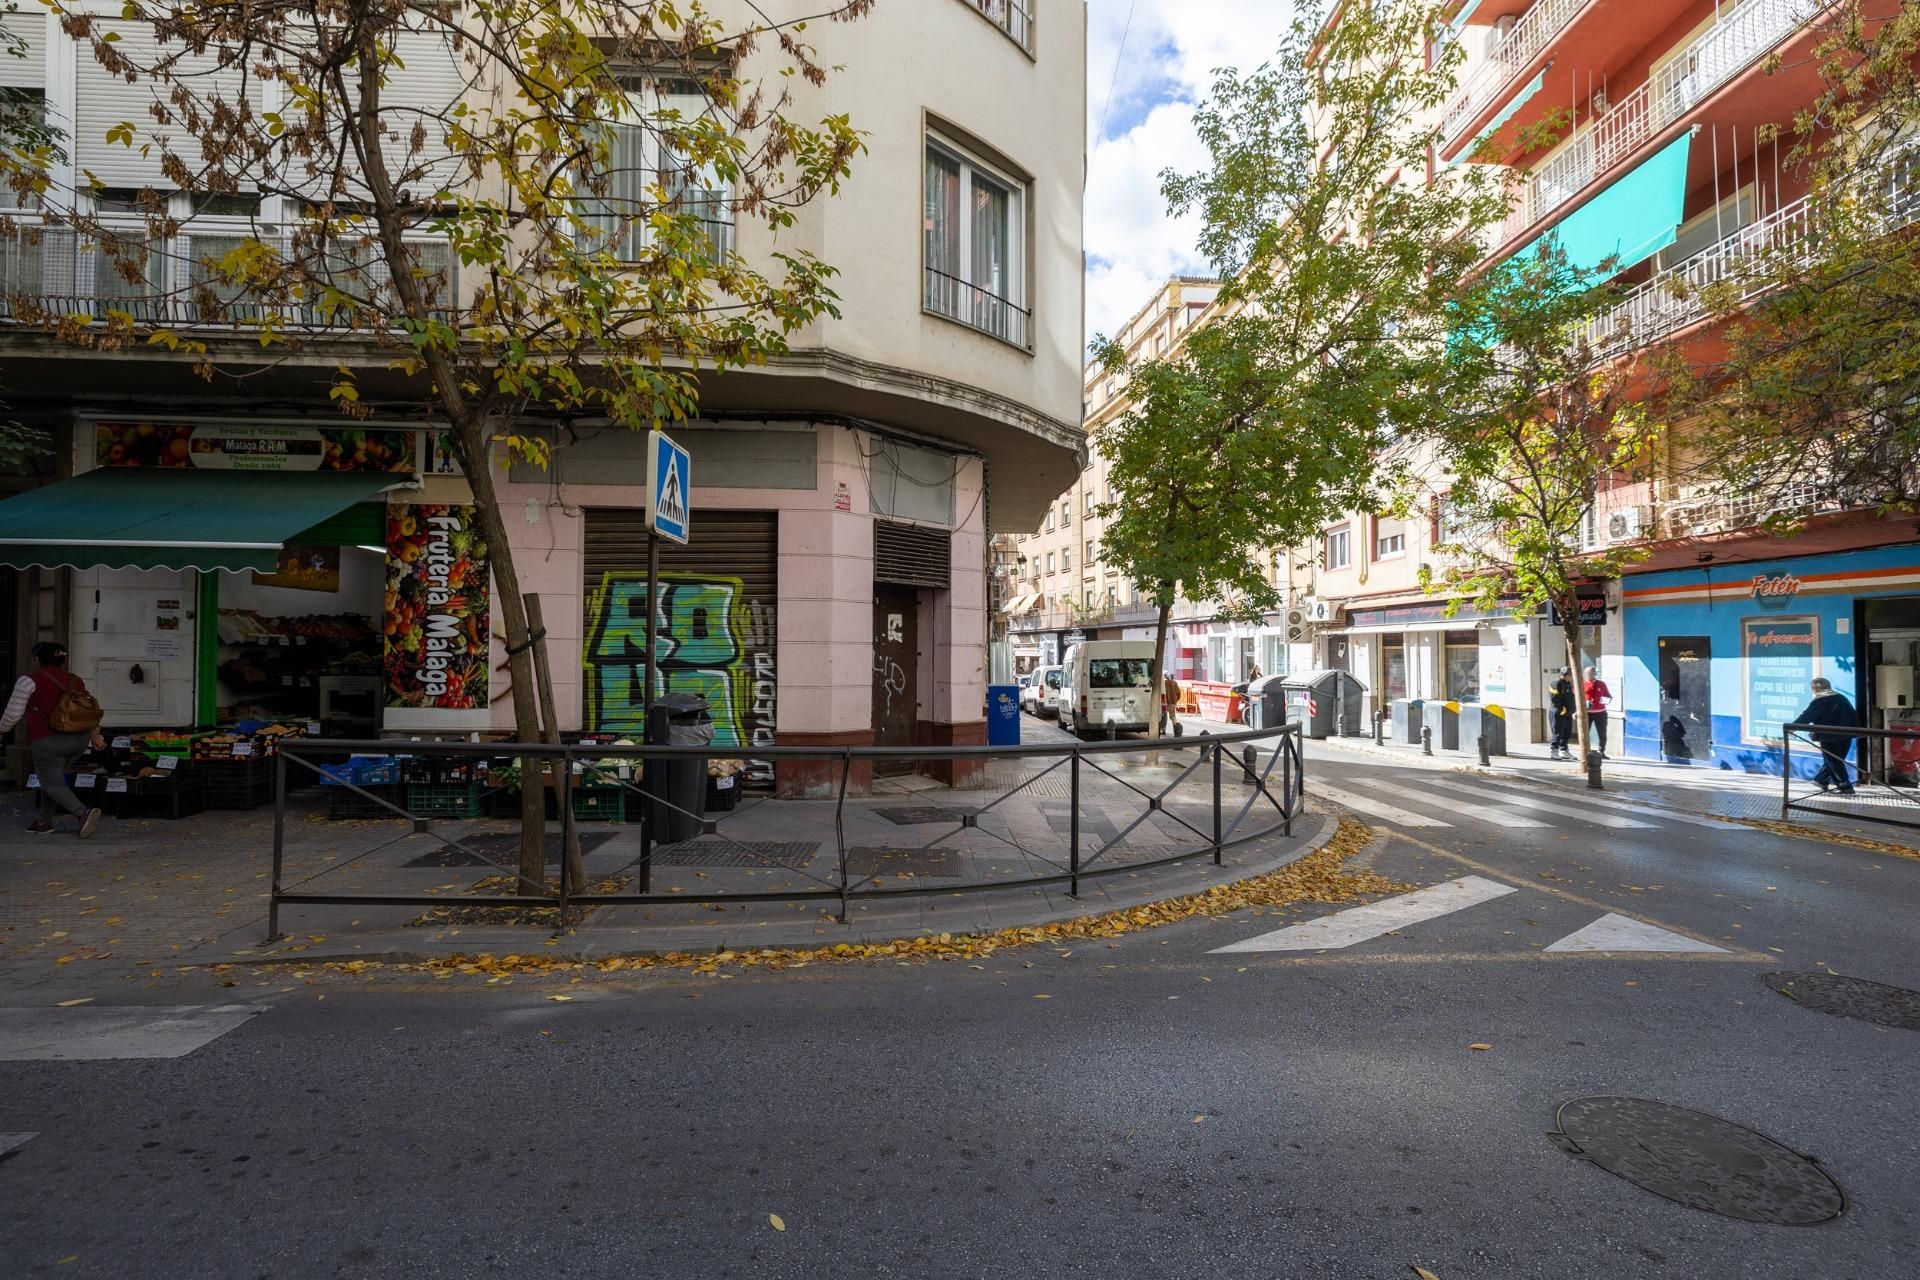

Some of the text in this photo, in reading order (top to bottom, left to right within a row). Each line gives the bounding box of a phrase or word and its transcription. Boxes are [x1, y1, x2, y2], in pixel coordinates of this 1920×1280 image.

[415, 516, 462, 696] Frutería Málaga
[1750, 573, 1800, 598] Fetén
